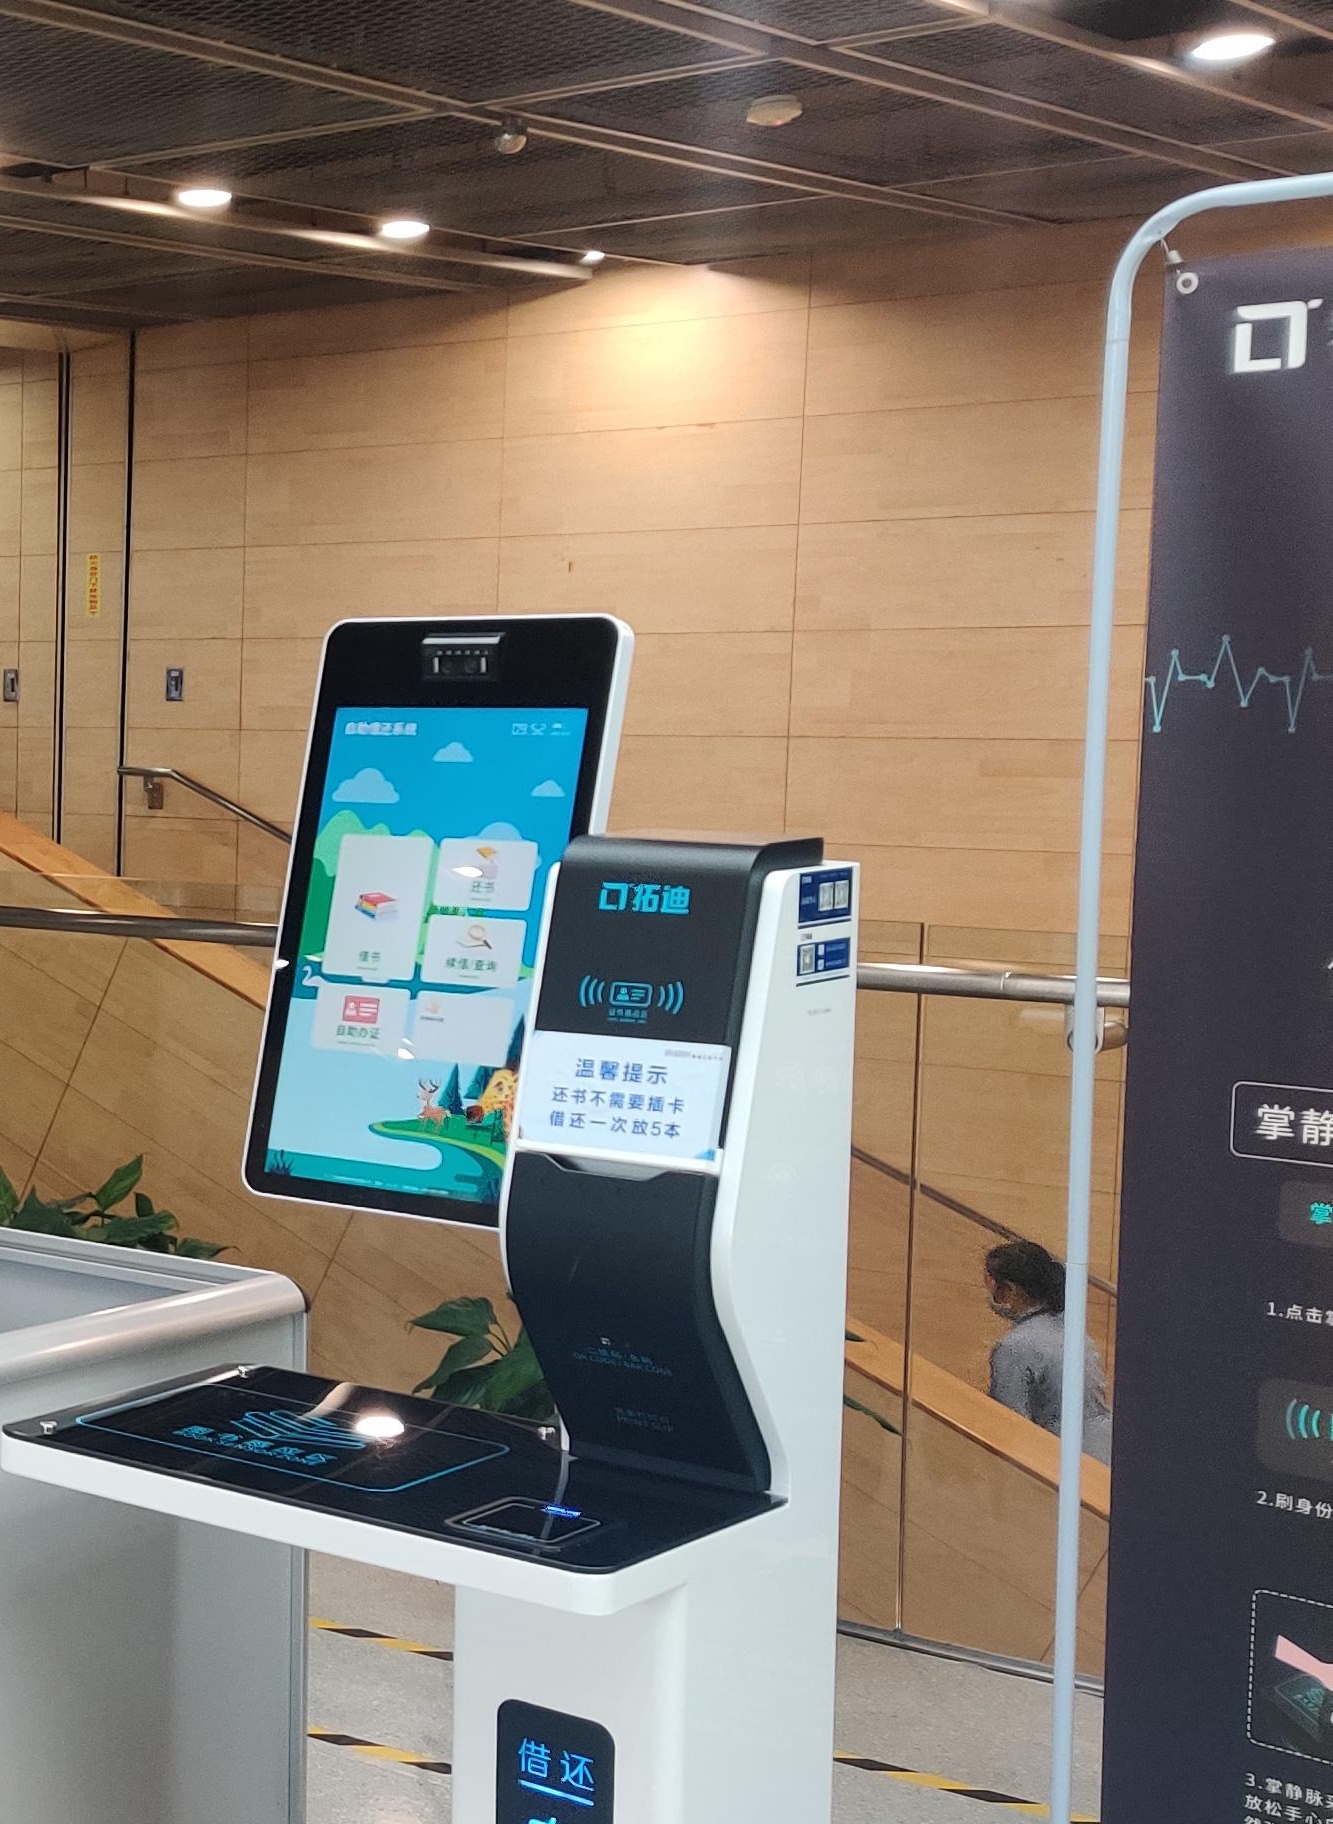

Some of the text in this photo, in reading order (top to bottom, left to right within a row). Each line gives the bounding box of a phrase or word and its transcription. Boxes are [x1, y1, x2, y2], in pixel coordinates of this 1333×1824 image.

[632, 882, 691, 915] 拓迪
[336, 1024, 381, 1040] 自助办证
[574, 1057, 668, 1085] 温馨提示
[552, 1085, 685, 1114] 还书不需要插卡
[549, 1110, 681, 1139] 借还一次放5本
[1255, 1104, 1333, 1146] 掌静
[518, 1738, 594, 1791] 借还
